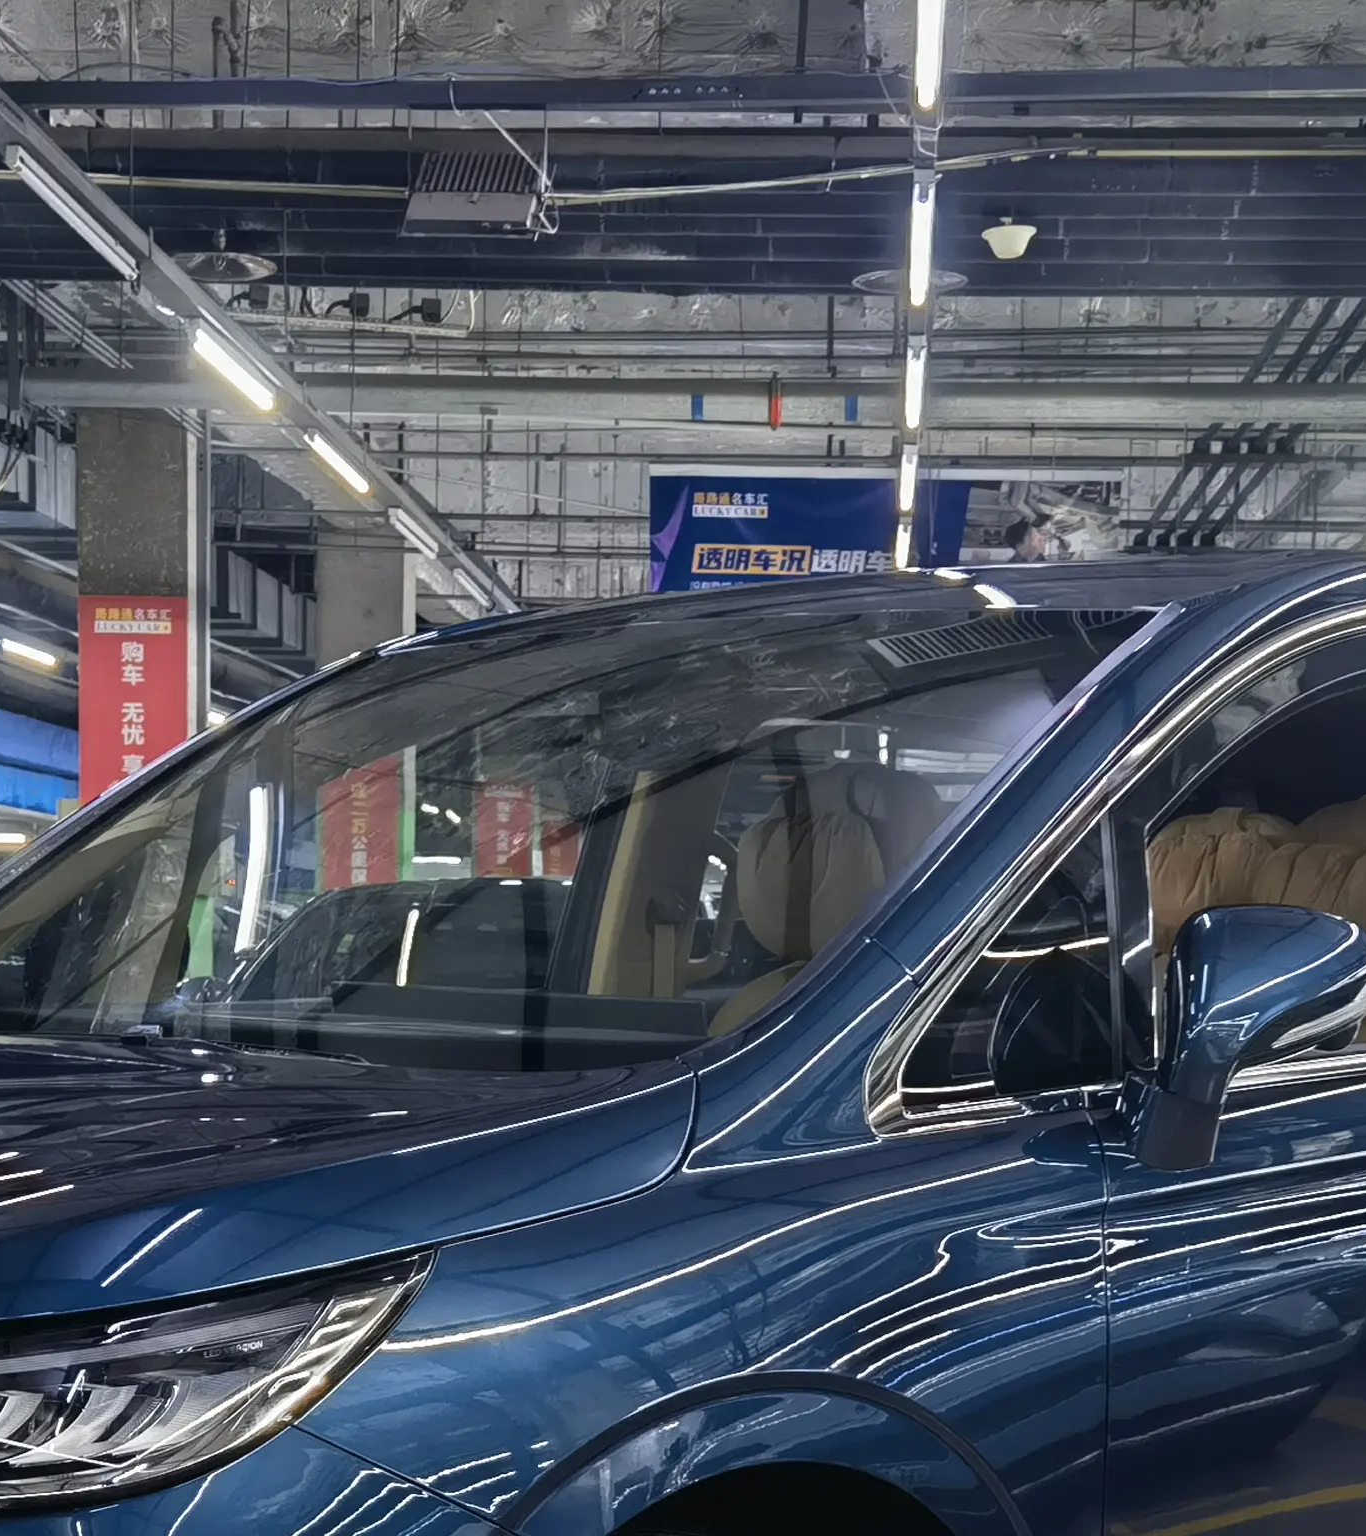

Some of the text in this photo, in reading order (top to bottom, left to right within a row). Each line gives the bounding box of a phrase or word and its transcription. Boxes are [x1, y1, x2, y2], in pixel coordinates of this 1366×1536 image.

[696, 547, 806, 572] 透明车况
[120, 641, 145, 686] 购车
[121, 702, 145, 745] 无忧
